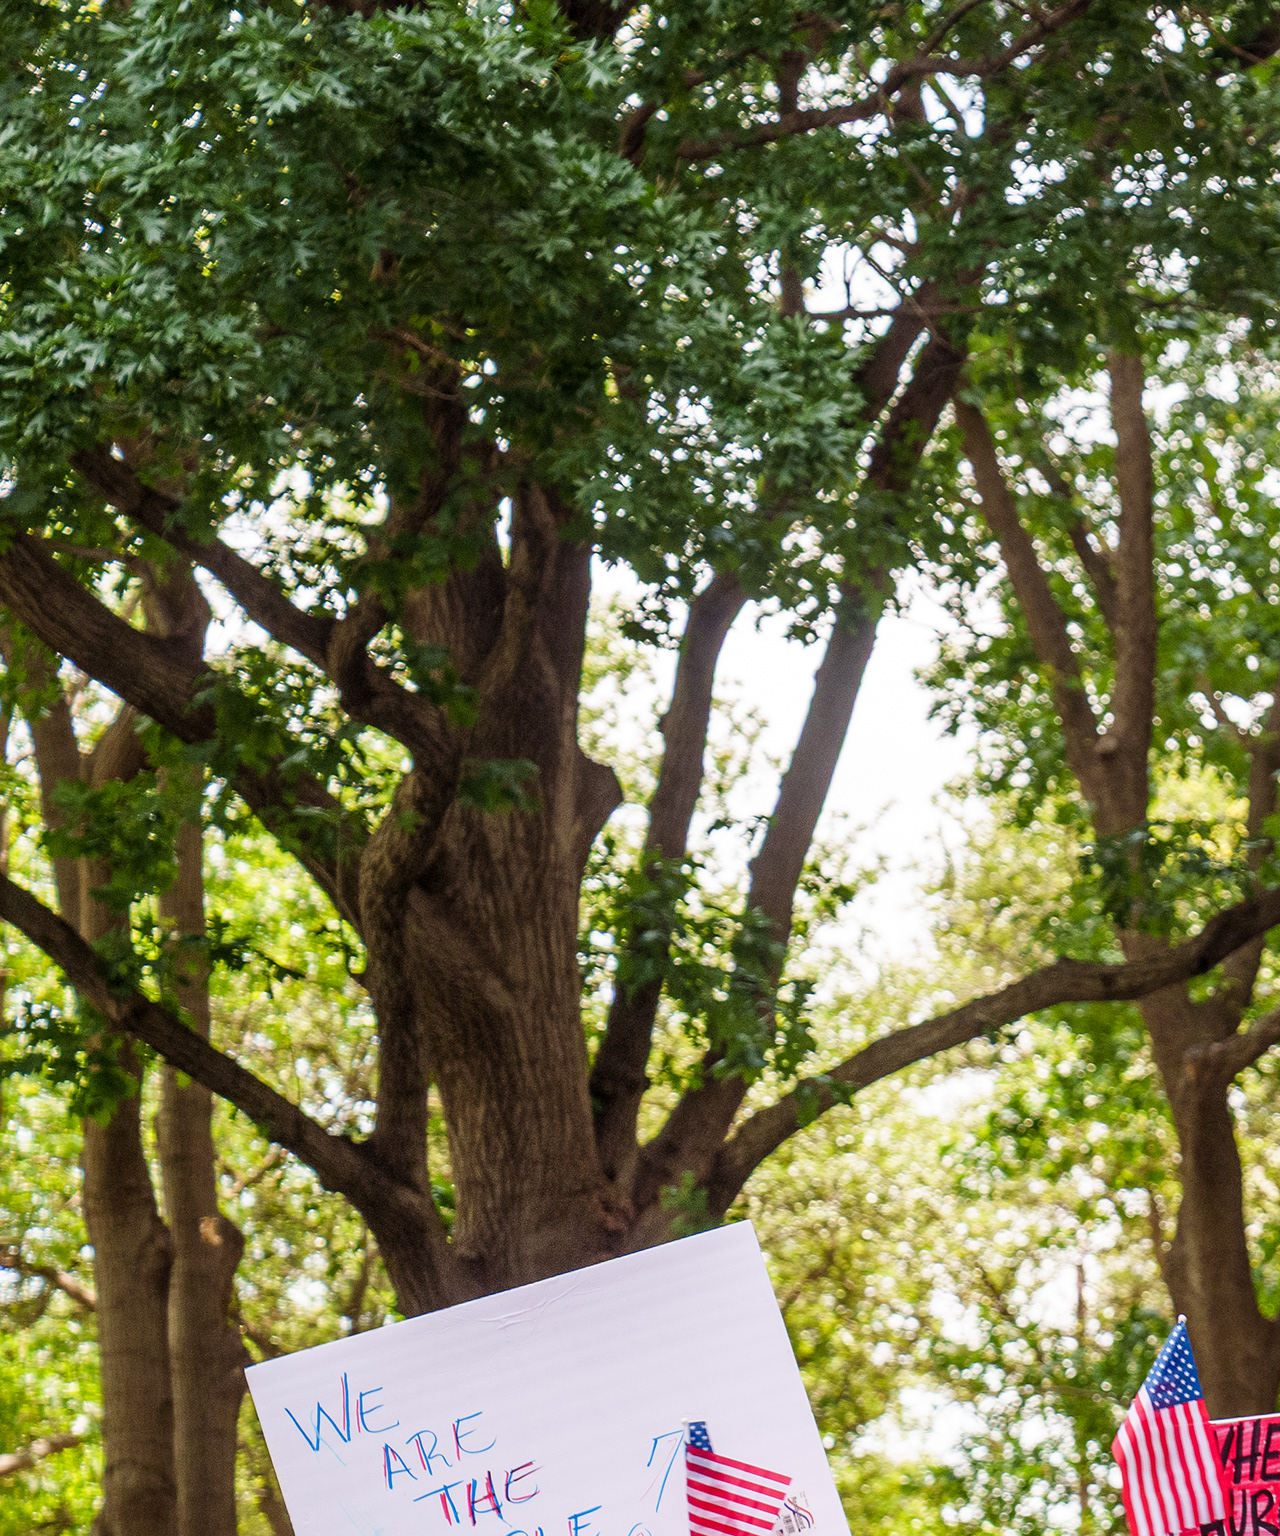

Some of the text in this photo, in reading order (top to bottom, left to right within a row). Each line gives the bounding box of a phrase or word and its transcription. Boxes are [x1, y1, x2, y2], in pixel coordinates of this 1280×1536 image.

[284, 1372, 400, 1452] WE
[383, 1411, 498, 1490] ARE
[413, 1460, 545, 1527] THE
